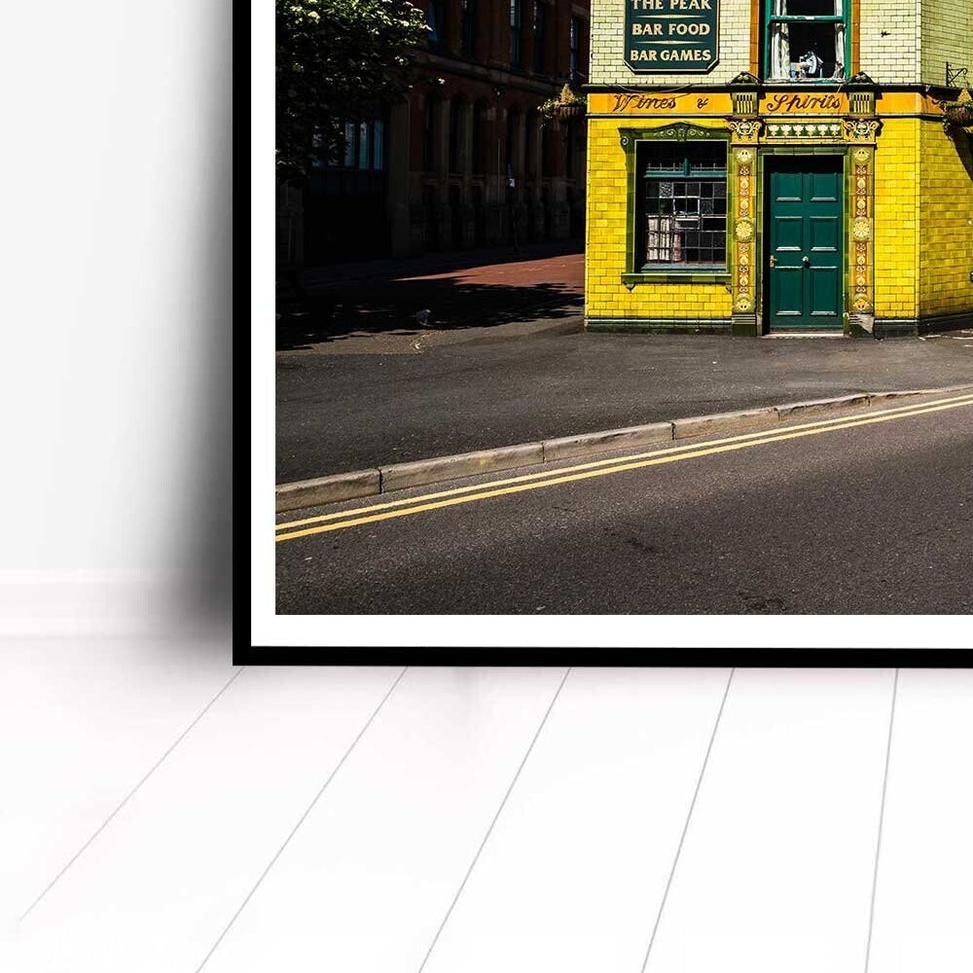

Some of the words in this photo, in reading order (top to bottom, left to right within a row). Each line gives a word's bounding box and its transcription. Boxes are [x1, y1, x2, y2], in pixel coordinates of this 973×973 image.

[631, 24, 664, 36] BAR
[668, 24, 711, 36] FOOD
[630, 50, 657, 62] BAR
[660, 49, 711, 61] GAMES
[612, 94, 677, 112] Wines
[696, 98, 708, 109] &
[766, 94, 841, 112] Spirits
